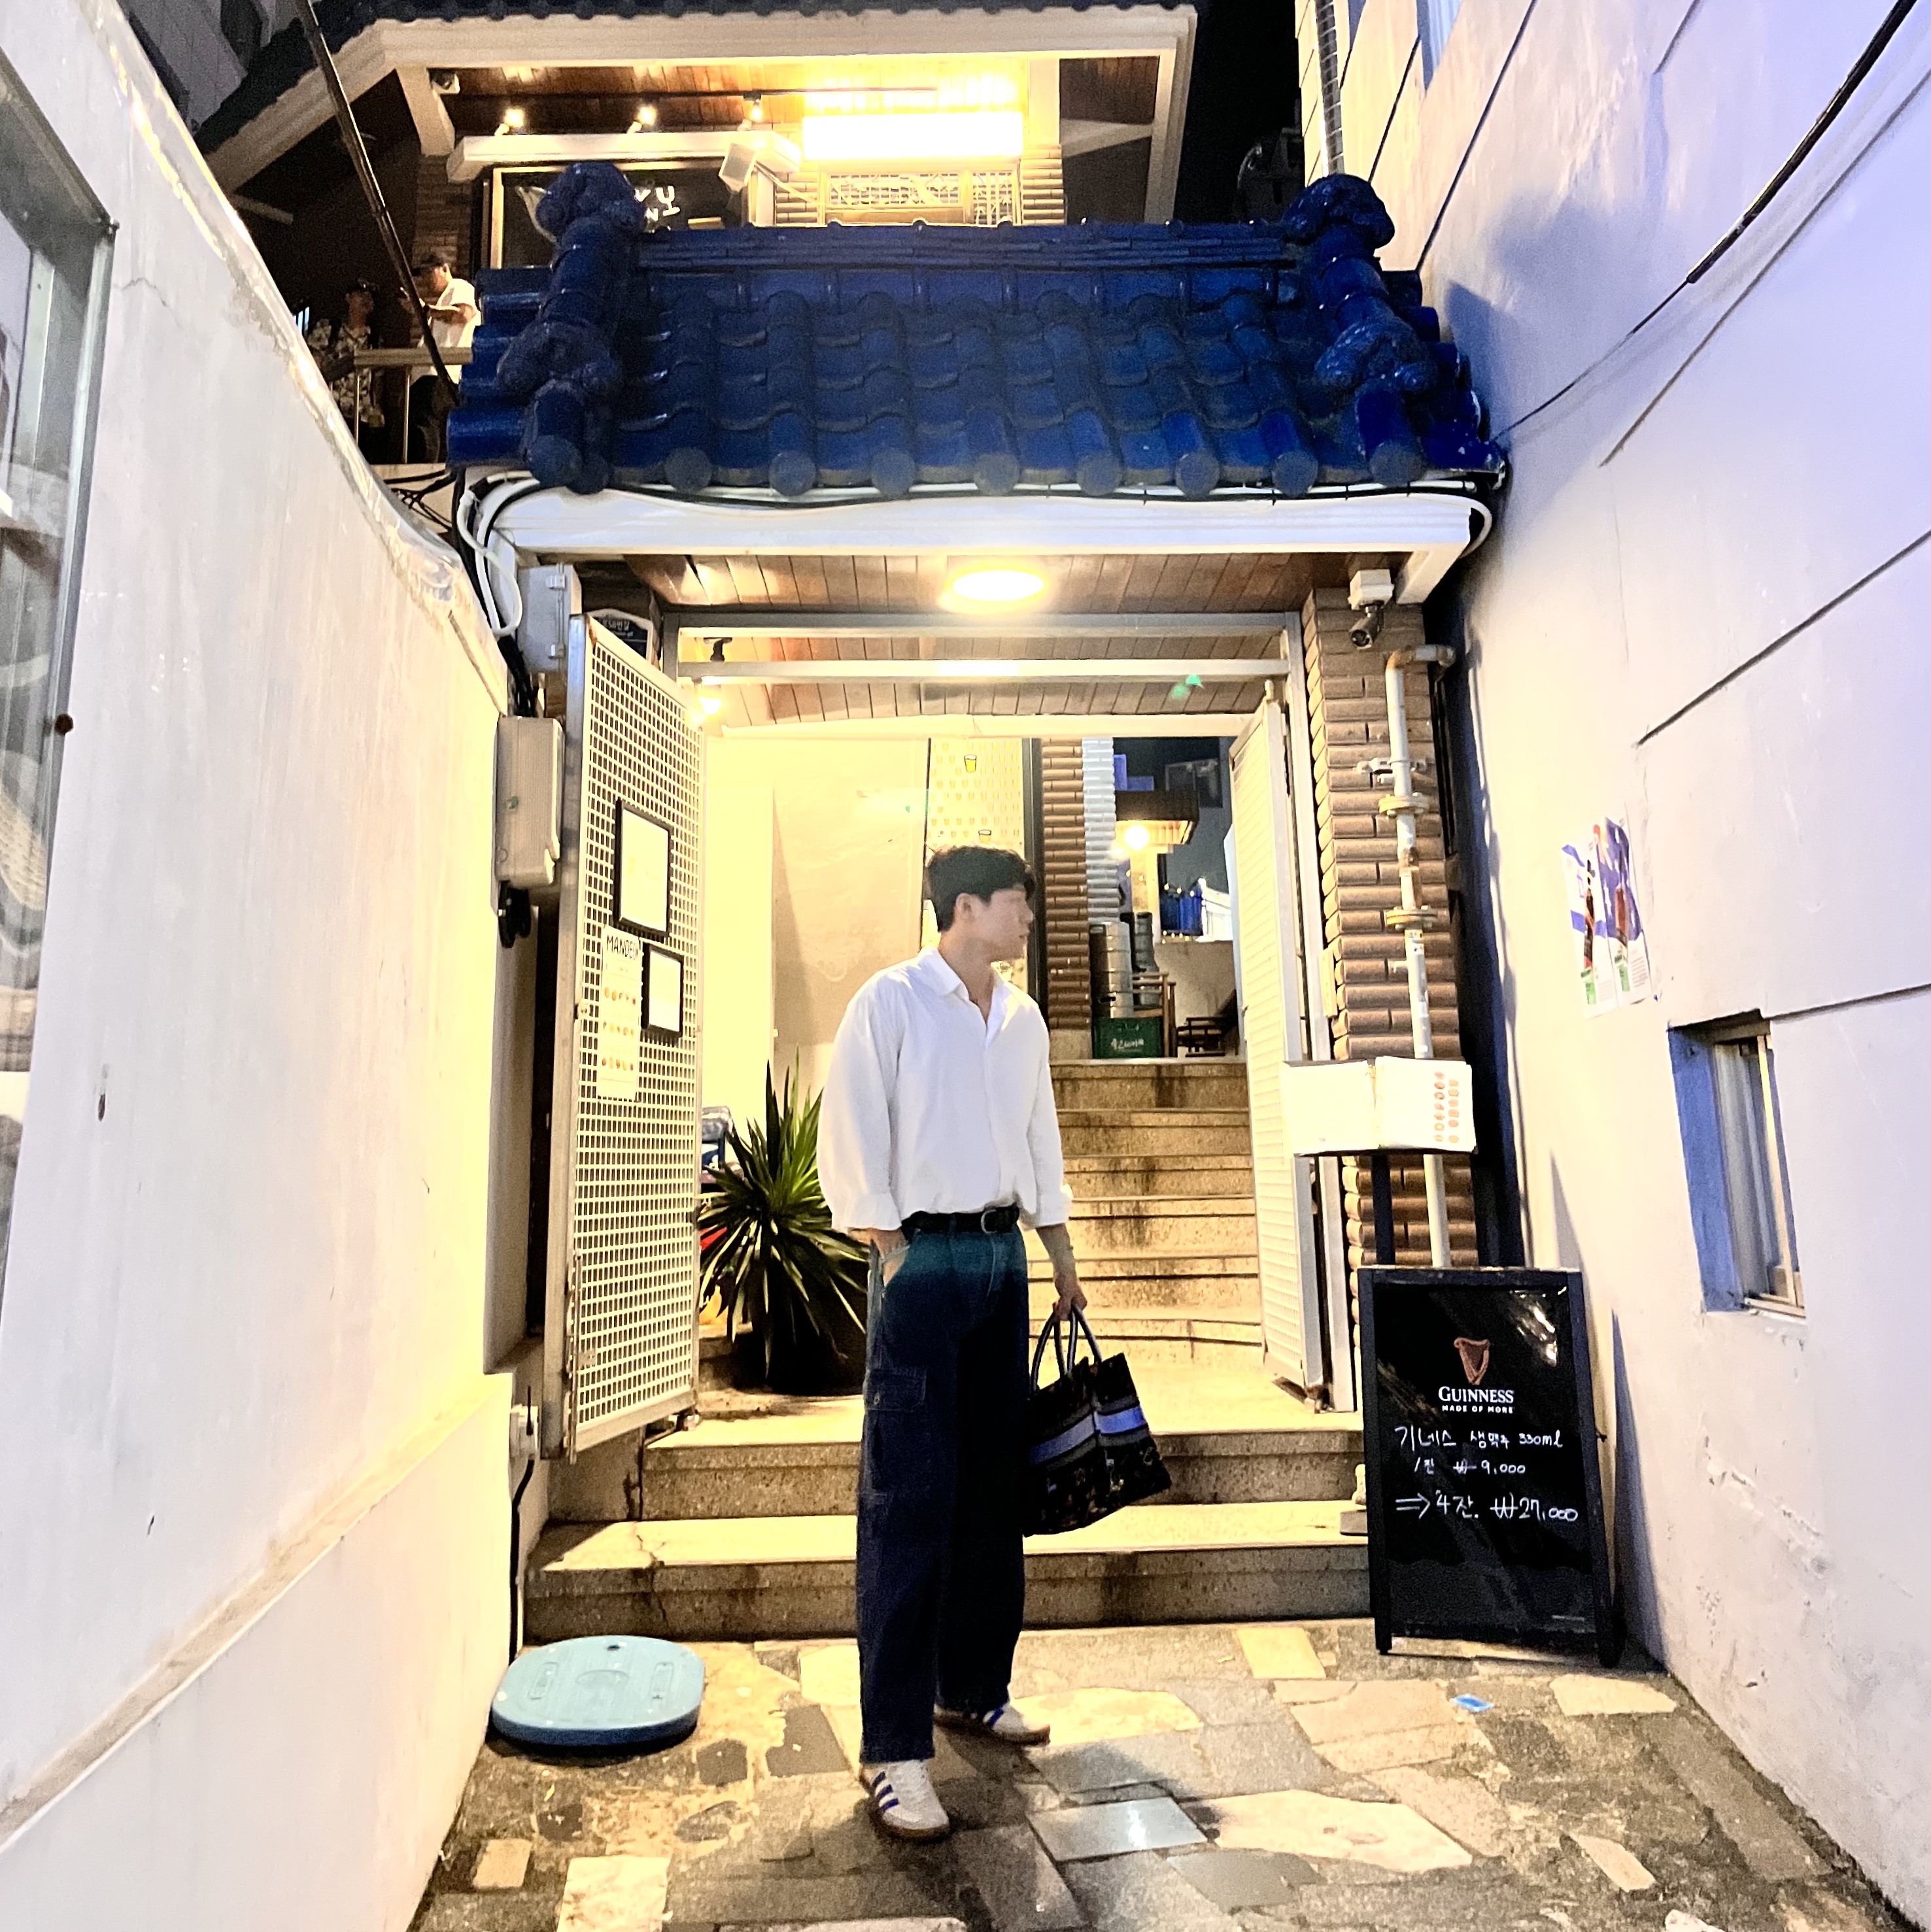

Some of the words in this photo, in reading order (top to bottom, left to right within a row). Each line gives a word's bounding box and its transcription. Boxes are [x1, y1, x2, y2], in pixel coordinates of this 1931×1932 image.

[1438, 1385, 1514, 1404] GUINNESS
[1394, 1425, 1457, 1451] 기네스
[1470, 1430, 1510, 1449] 생맥주
[1518, 1429, 1563, 1448] 330ml
